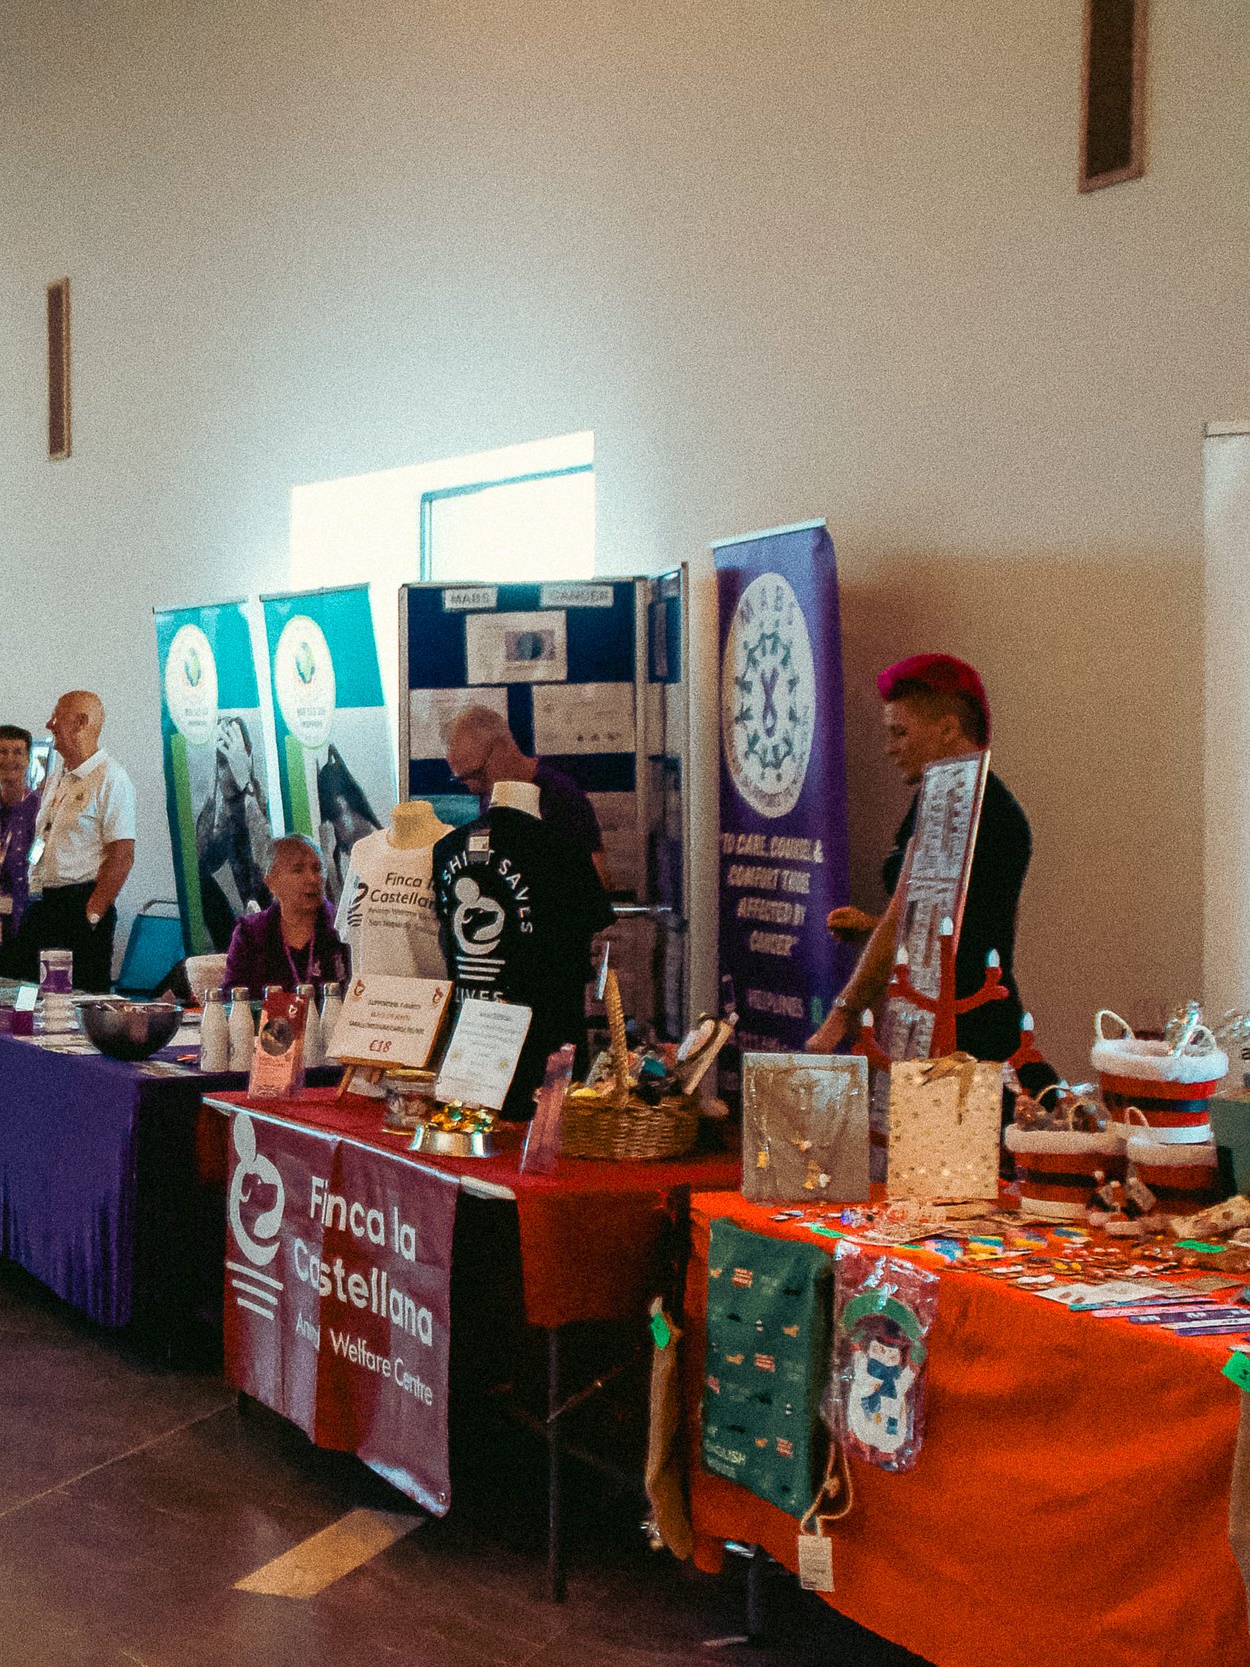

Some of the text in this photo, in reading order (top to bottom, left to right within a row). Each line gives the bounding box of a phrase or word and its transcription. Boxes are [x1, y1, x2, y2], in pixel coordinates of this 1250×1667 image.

[450, 592, 490, 605] MABS
[813, 838, 824, 863] &
[385, 872, 423, 888] Finca
[442, 849, 495, 885] SHIT
[498, 858, 533, 934] SAVES
[369, 1039, 392, 1053] €18
[310, 1175, 416, 1262] Finca la
[294, 1238, 433, 1347] Castellana
[330, 1328, 391, 1377] Welfare
[394, 1357, 433, 1406] Centre
